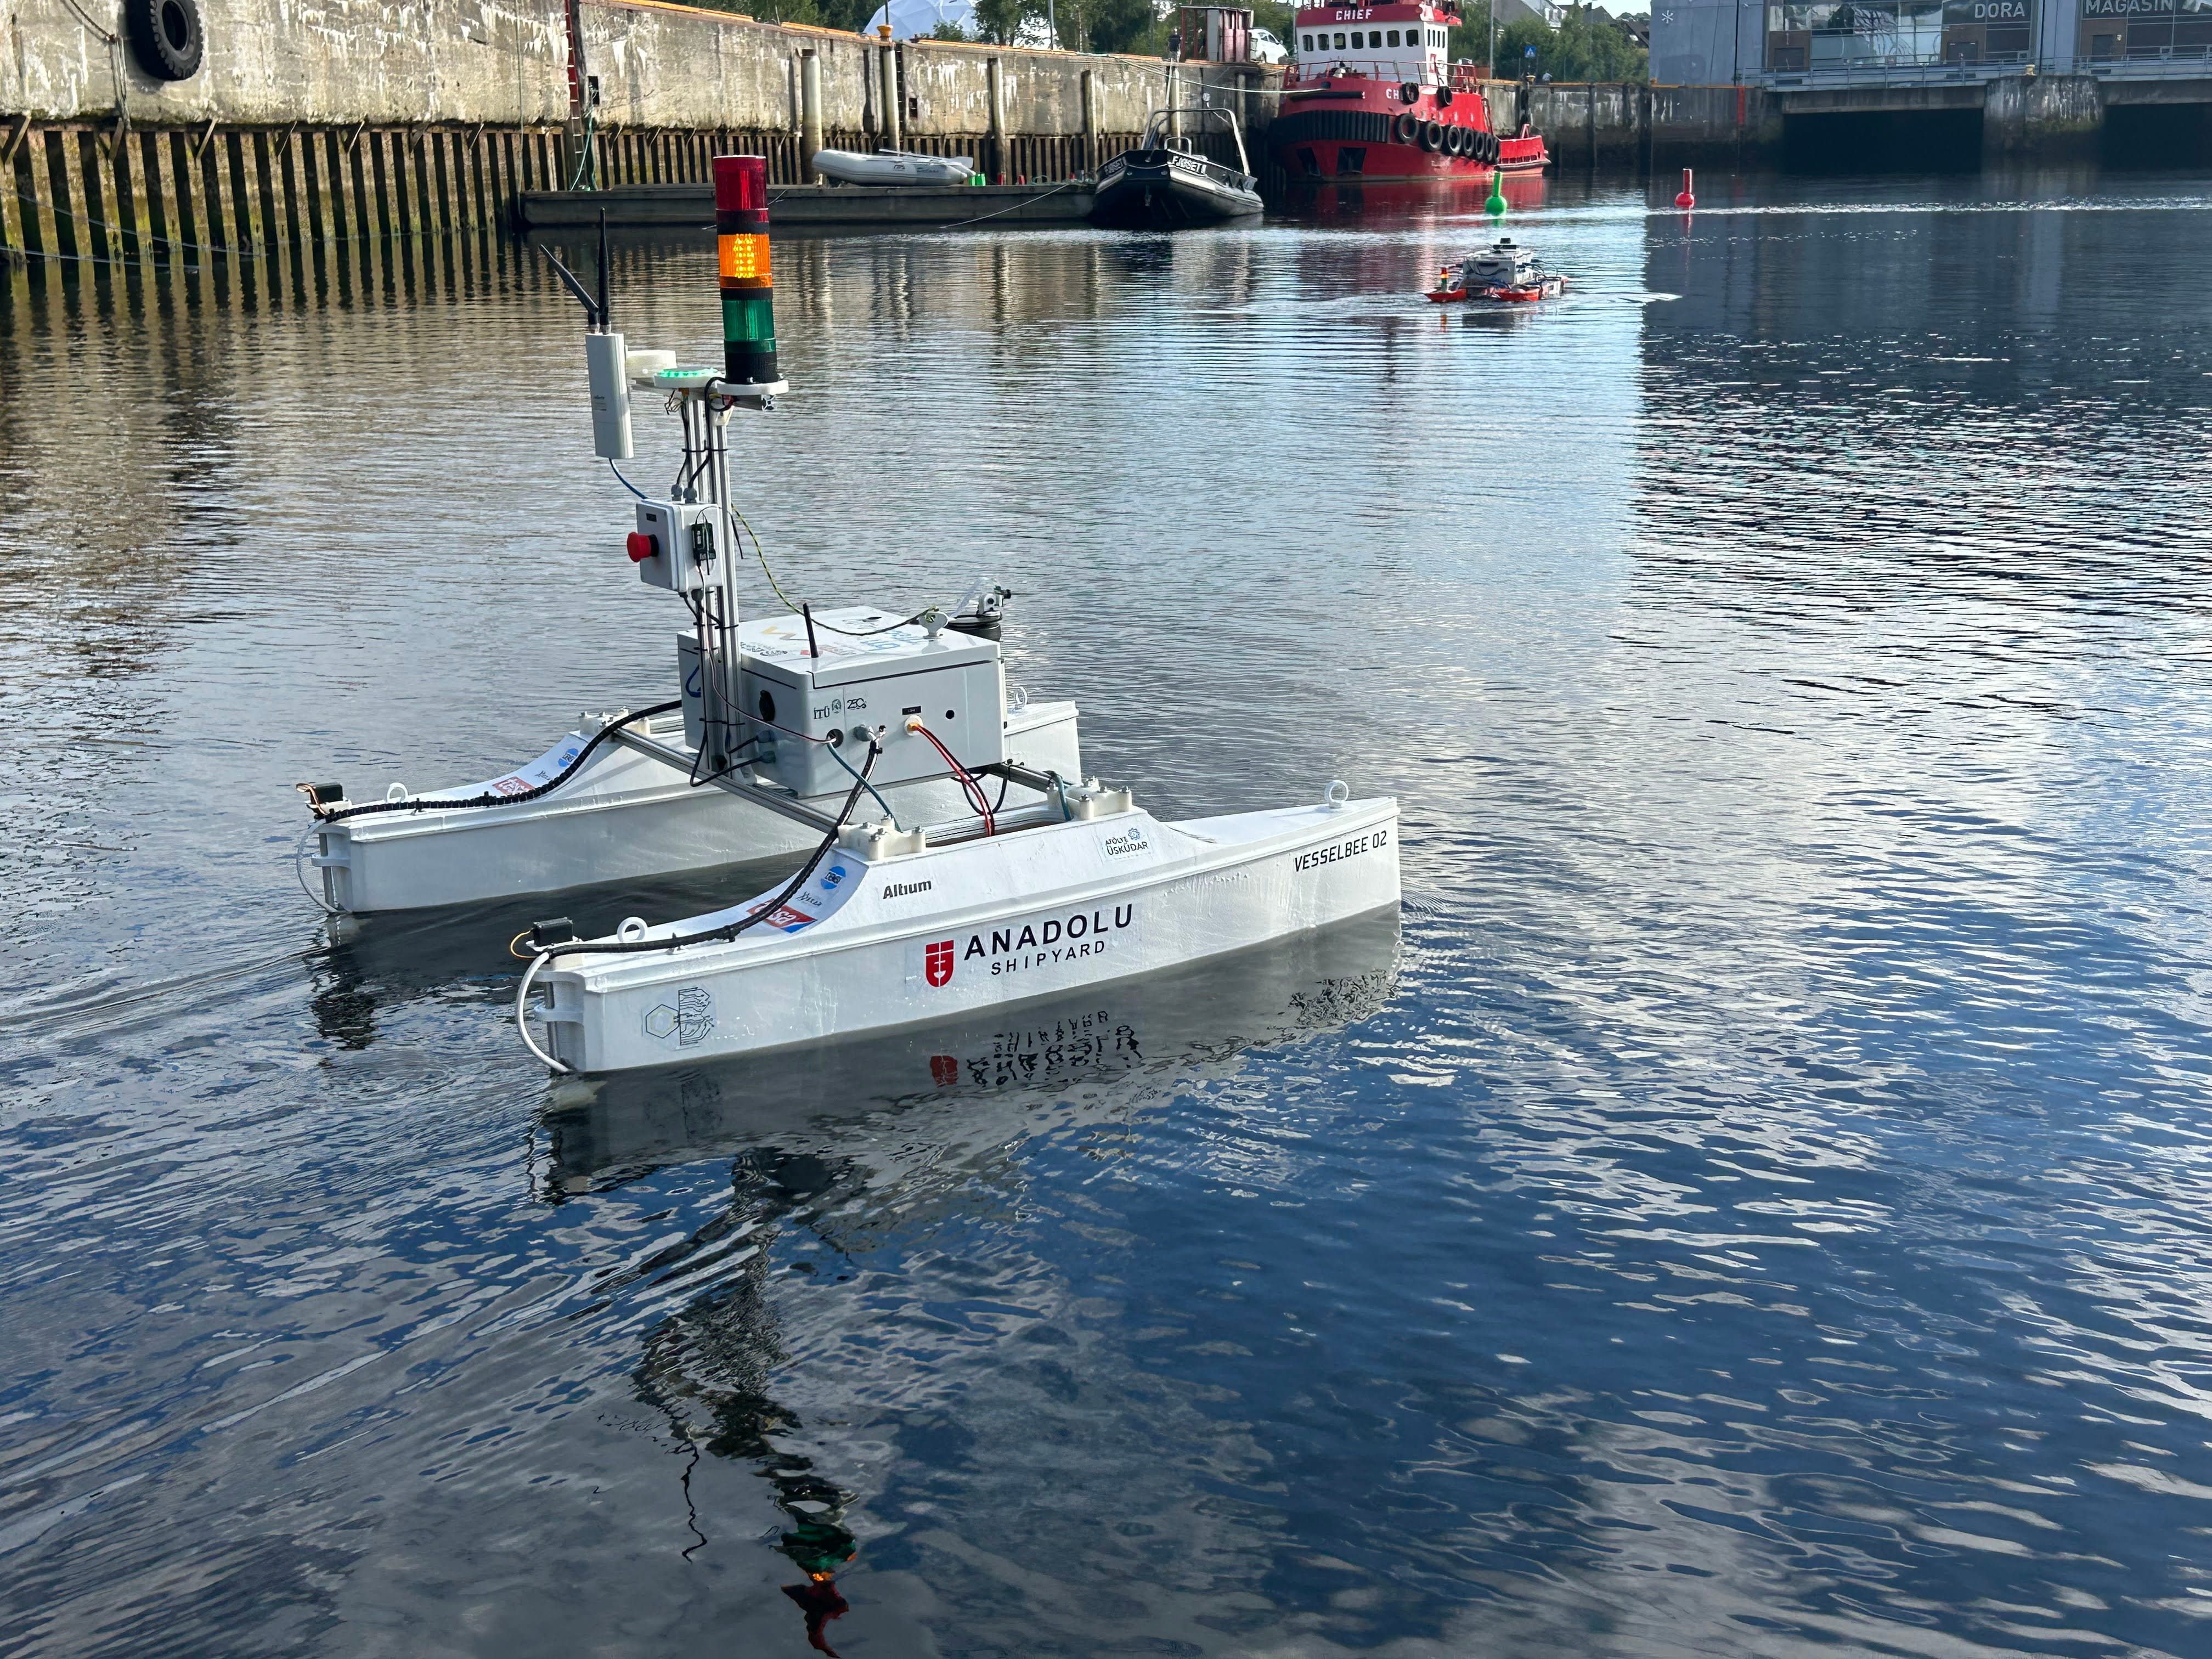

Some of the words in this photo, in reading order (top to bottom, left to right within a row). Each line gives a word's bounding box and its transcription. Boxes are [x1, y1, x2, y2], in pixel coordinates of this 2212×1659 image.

[1335, 9, 1373, 21] CHIEF
[1974, 2, 2025, 18] DORA
[2085, 0, 2173, 14] MAGASIN
[1294, 836, 1369, 872] VESSELBEE
[1373, 830, 1387, 849] 02
[883, 881, 932, 899] Altium
[964, 904, 1132, 961] ANADOLU
[991, 940, 1105, 975] SHIPYARD
